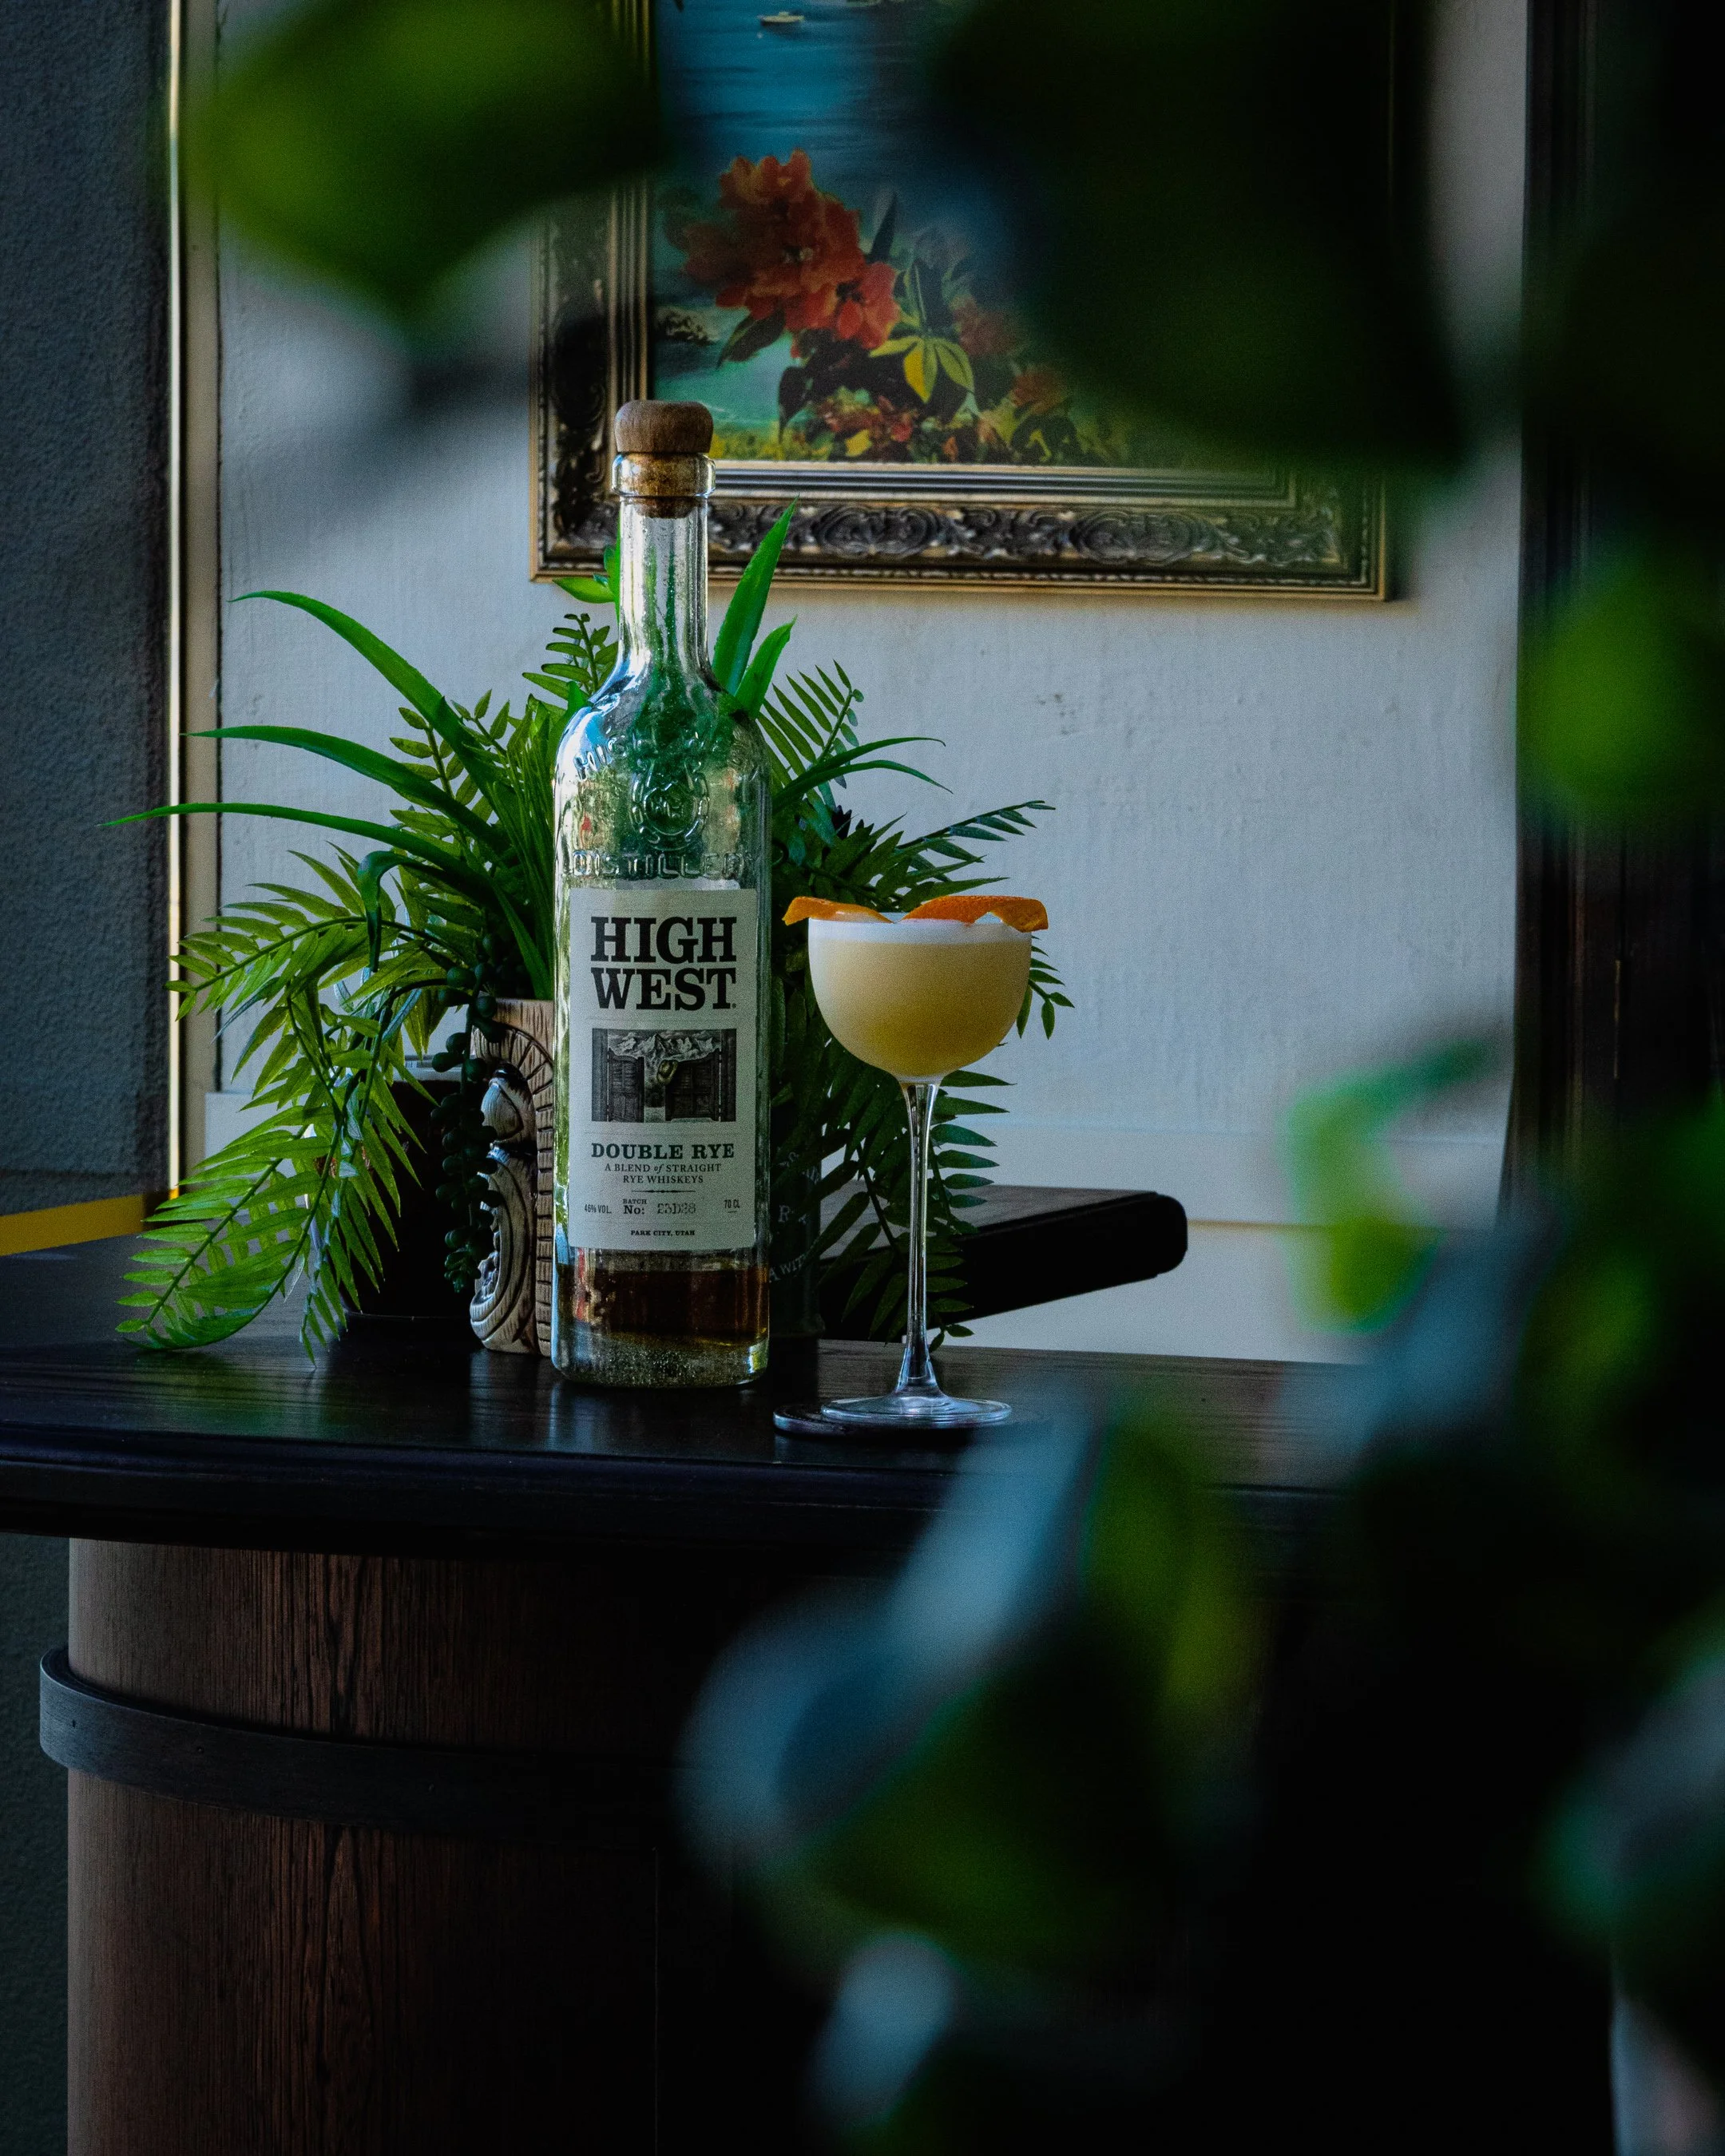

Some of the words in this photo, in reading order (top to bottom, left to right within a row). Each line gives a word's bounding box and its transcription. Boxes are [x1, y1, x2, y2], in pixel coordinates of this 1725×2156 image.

[590, 916, 737, 964] HIGH
[591, 1143, 684, 1159] DOUBLE
[692, 1143, 735, 1159] RYE
[605, 1163, 612, 1171] A
[614, 1163, 650, 1172] BLEND
[653, 1163, 664, 1173] of
[666, 1163, 722, 1172] STRAIGHT
[623, 1175, 644, 1183] RYE
[647, 1175, 704, 1184] WHISKEYS
[584, 1203, 597, 1214] 46%
[724, 1199, 732, 1209] 70
[732, 1199, 741, 1209] CL
[623, 1205, 645, 1215] No:
